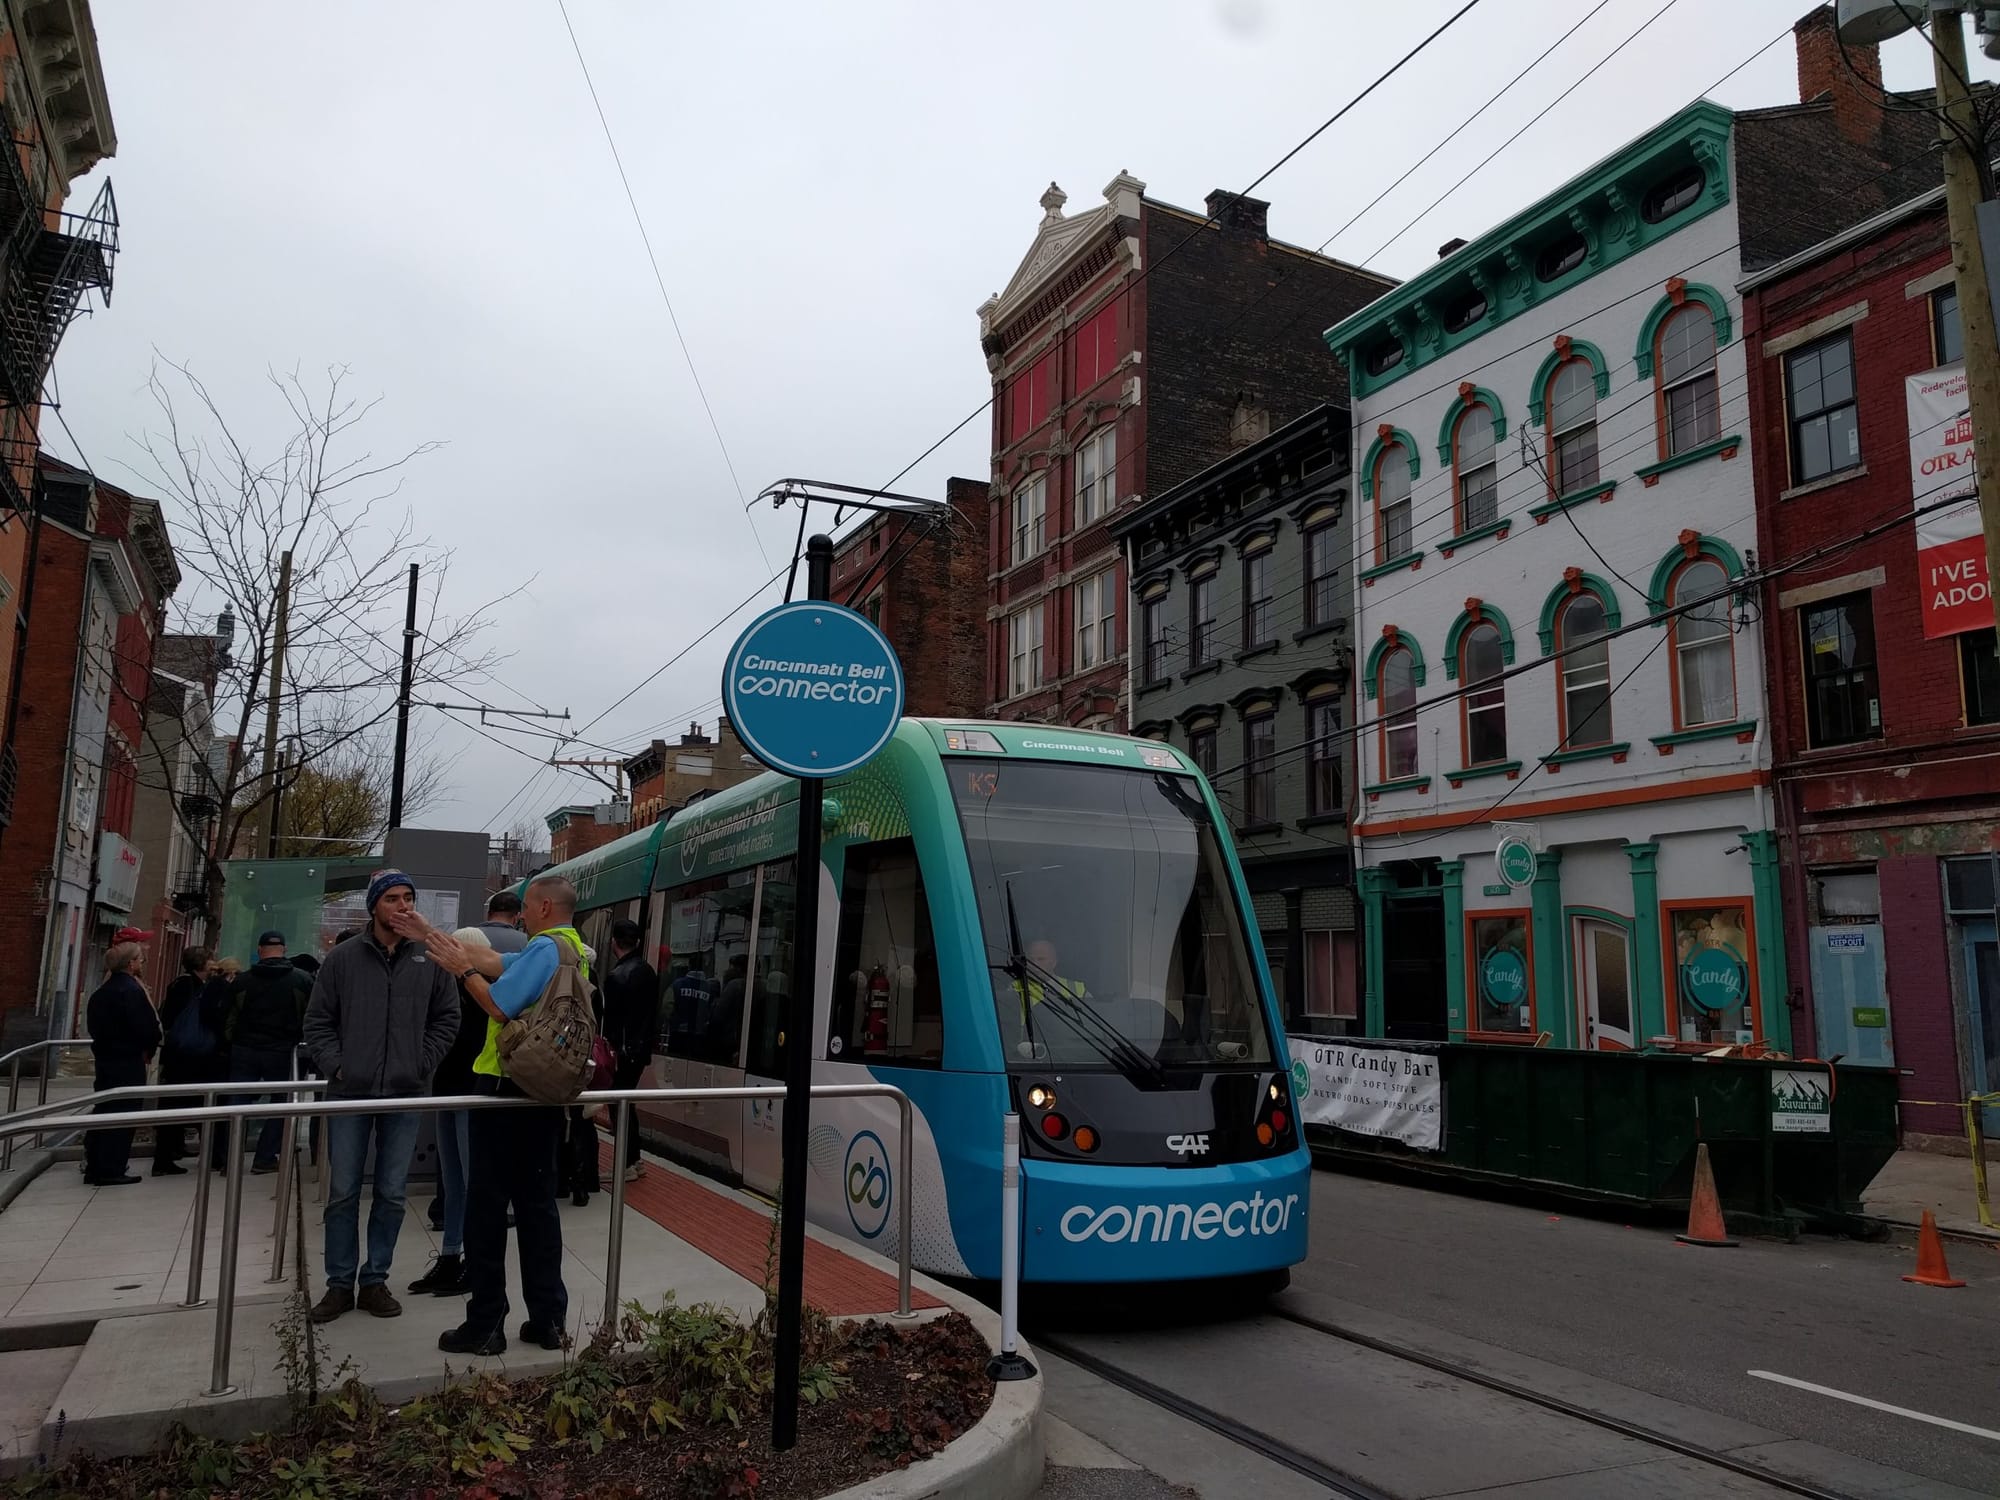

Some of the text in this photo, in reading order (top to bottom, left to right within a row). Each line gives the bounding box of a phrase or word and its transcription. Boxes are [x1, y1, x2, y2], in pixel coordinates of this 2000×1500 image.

[1920, 452, 1961, 475] OTR
[1931, 558, 1977, 587] I'VE
[743, 655, 886, 679] Cincinnati Bell
[738, 675, 893, 705] connector
[1022, 740, 1125, 757] Cincinnati Bell
[700, 791, 780, 845] Cincinnati Bell
[707, 831, 775, 865] connecting what matters
[1504, 855, 1530, 873] Candy
[1830, 938, 1863, 947] KEEP OUT
[1486, 966, 1523, 990] Candy
[1686, 965, 1741, 993] Candy
[1315, 1049, 1433, 1077] OTR Candy Bar
[1313, 1088, 1342, 1100] RETRO
[1343, 1094, 1371, 1105] SODAS
[1362, 1079, 1386, 1090] SOFT
[1779, 1097, 1823, 1110] Bavarian
[1166, 1134, 1210, 1155] CAF
[1060, 1190, 1299, 1243] connector
